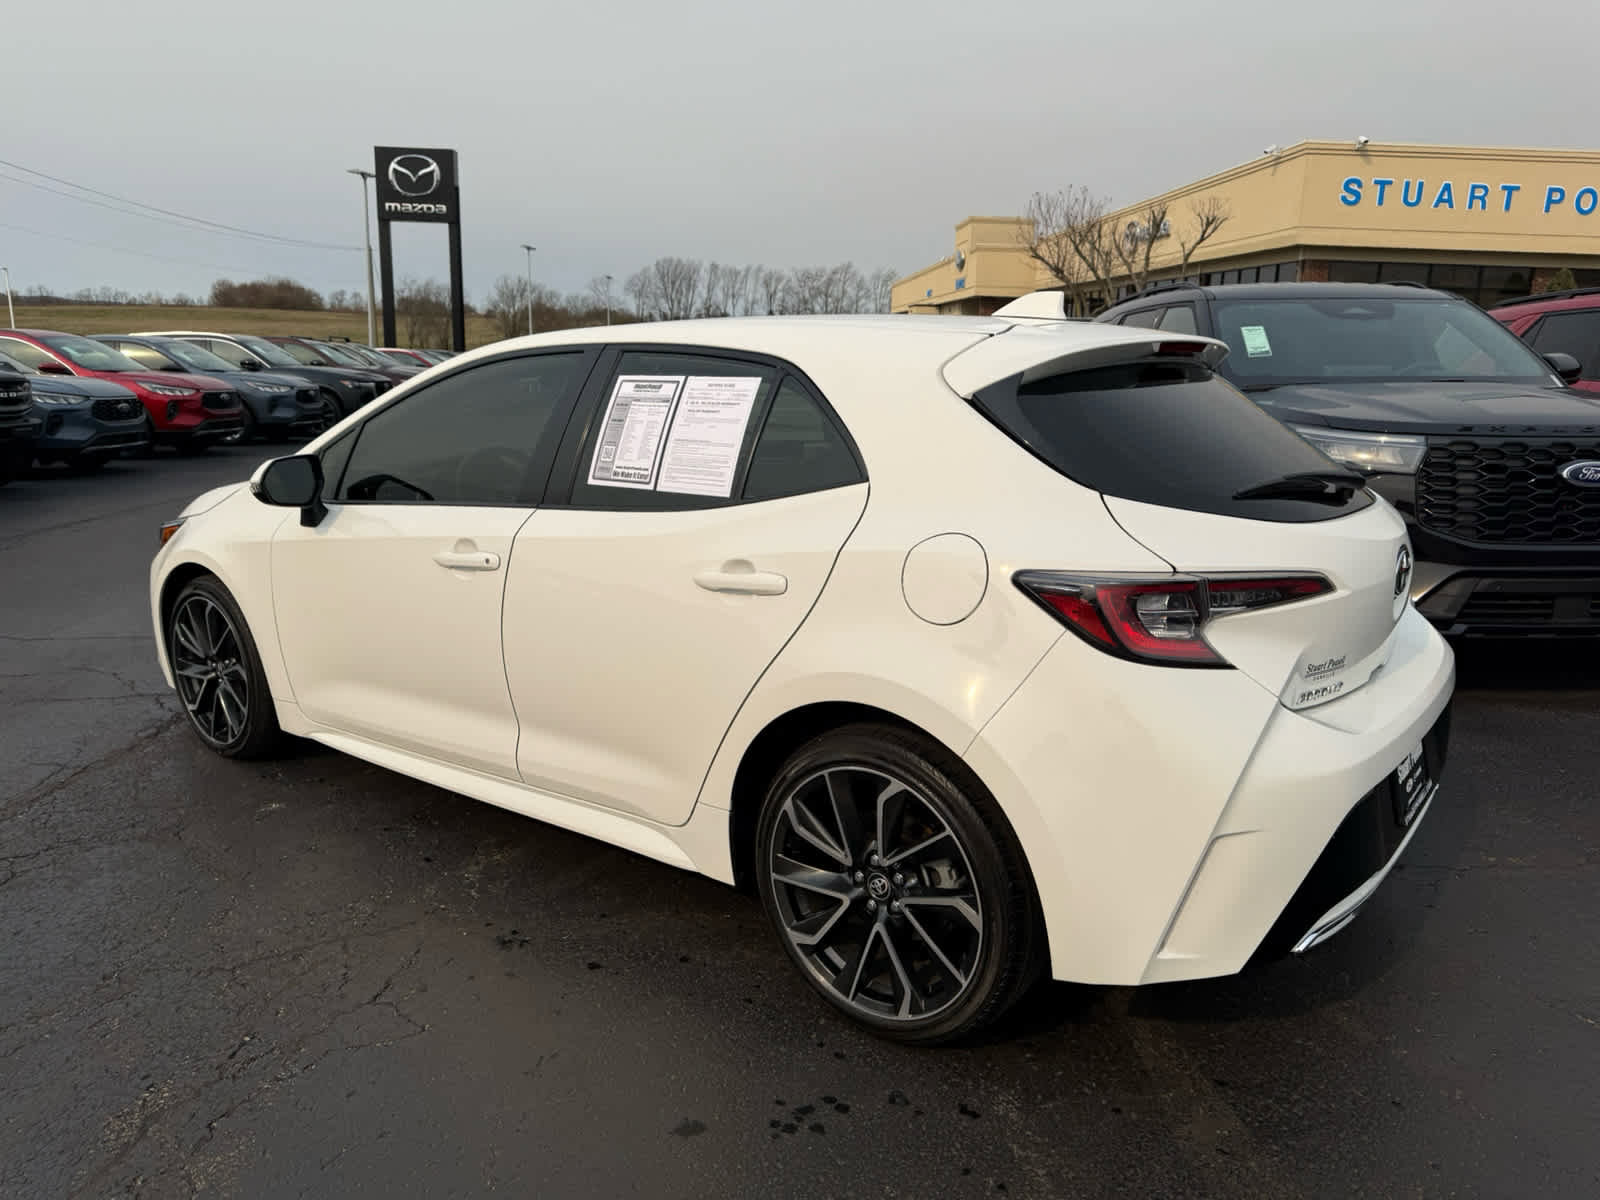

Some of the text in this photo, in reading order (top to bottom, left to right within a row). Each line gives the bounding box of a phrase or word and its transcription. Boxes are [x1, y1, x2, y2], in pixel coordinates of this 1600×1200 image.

[1340, 177, 1599, 216] STUART PO
[384, 202, 447, 214] mazda
[1306, 661, 1327, 674] Stuart
